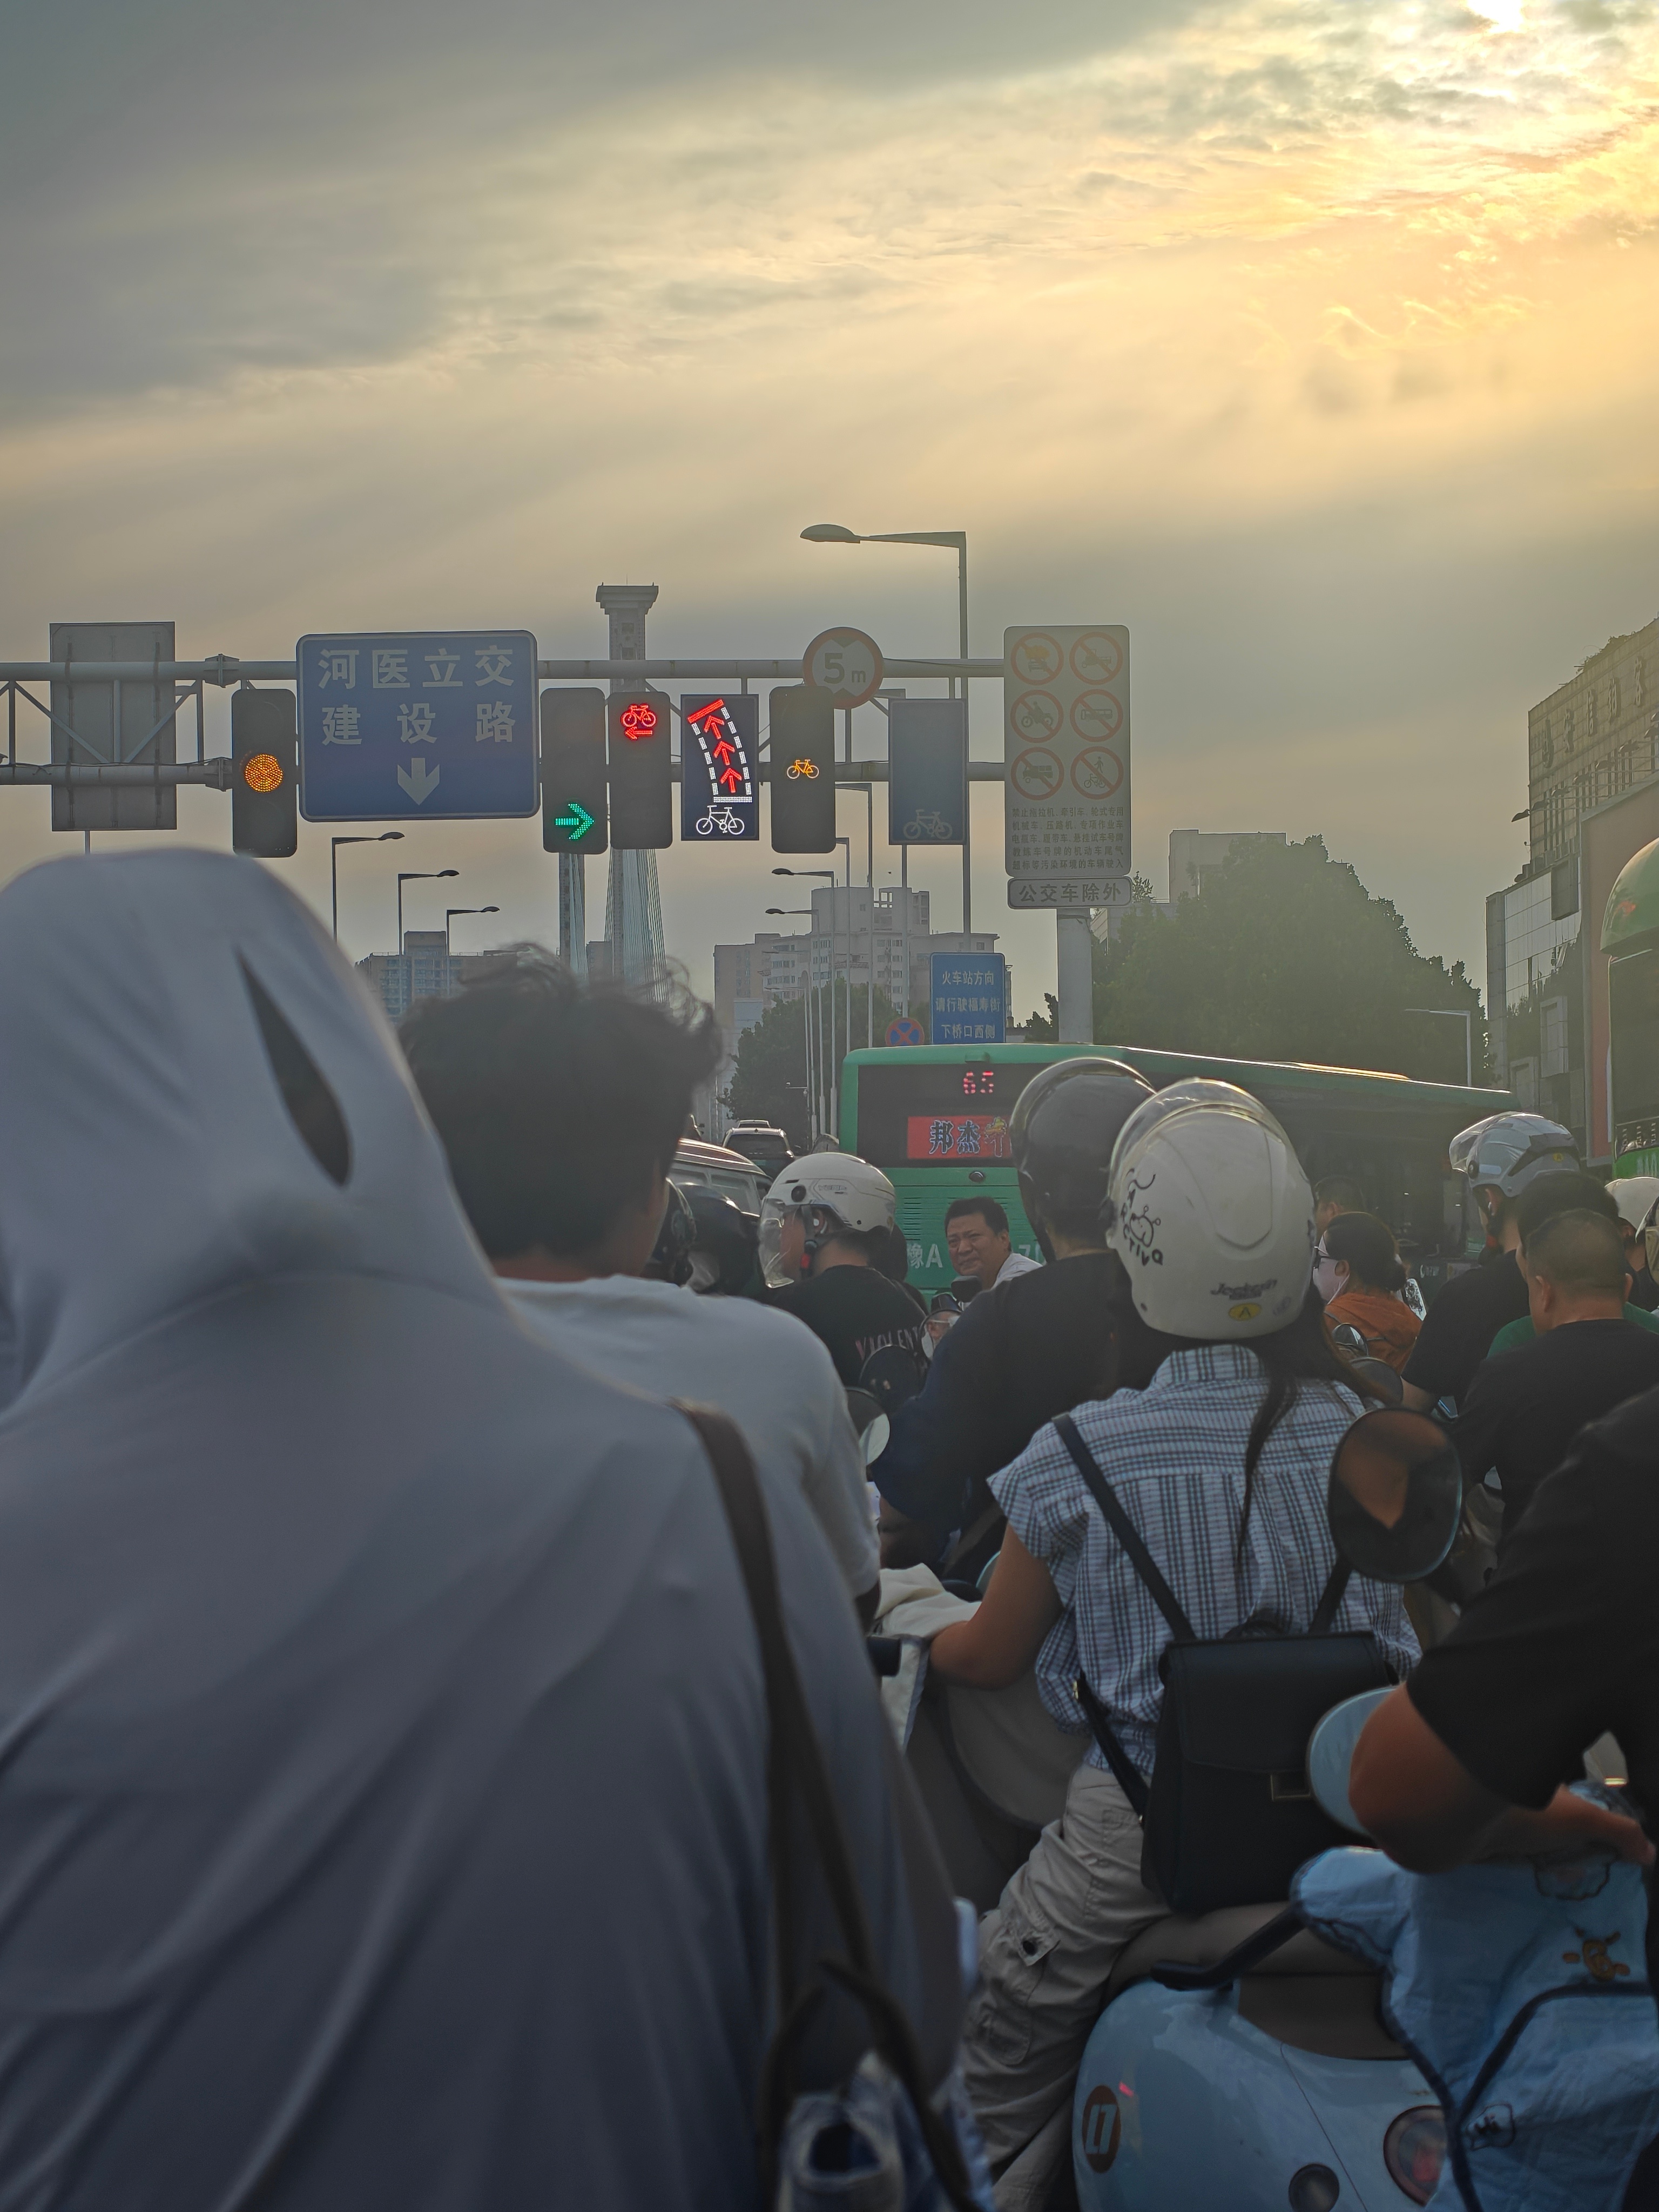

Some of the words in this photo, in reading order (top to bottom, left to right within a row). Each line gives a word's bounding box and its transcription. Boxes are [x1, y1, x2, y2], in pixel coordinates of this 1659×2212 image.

[318, 645, 514, 689] 河医立交
[322, 701, 516, 746] 建设路
[1019, 883, 1121, 902] 公交车除外
[942, 970, 994, 985] 火车站方向
[935, 997, 1001, 1013] 请行驶福寿街
[941, 1024, 995, 1038] 下桥口西侧
[963, 1070, 994, 1095] 65
